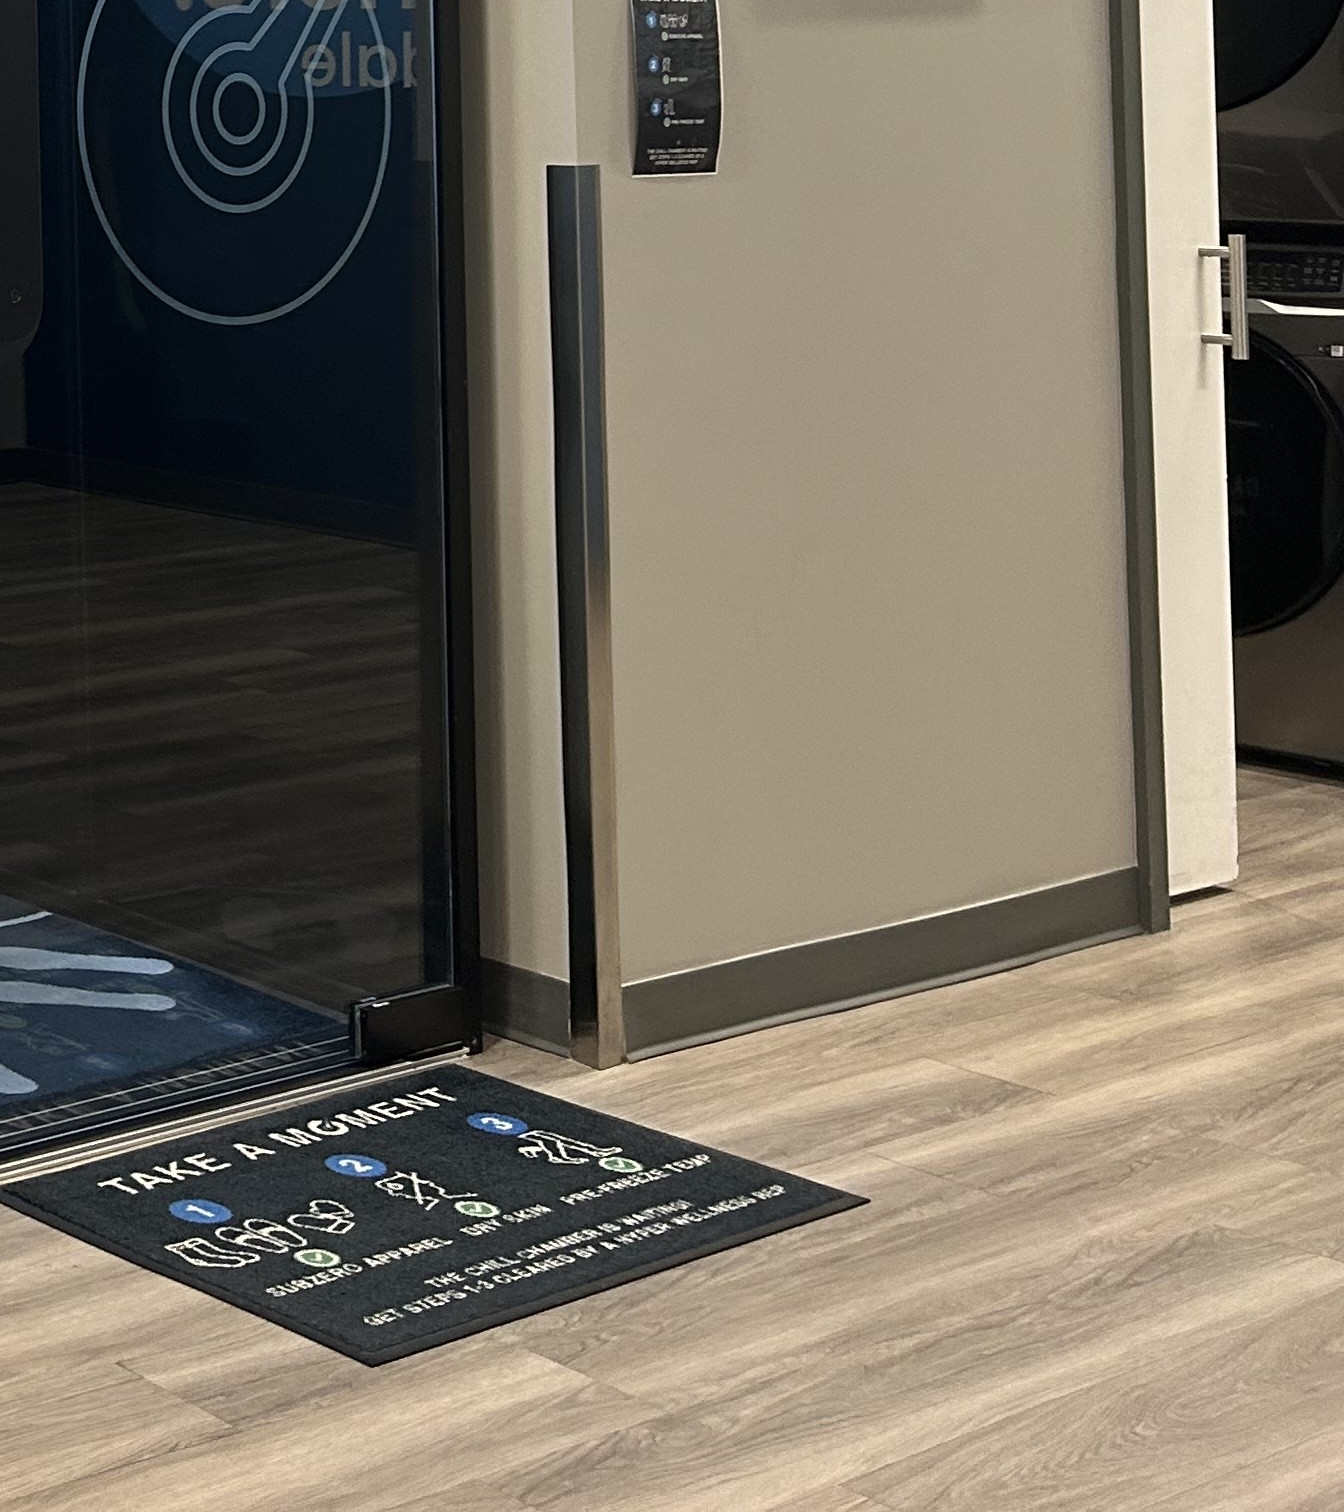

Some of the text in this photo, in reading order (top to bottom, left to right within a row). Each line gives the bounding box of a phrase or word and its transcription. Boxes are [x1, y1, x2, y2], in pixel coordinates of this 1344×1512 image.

[98, 1087, 457, 1196] TAKE A MOMENT
[483, 1117, 514, 1131] 3
[339, 1159, 374, 1174] 2
[560, 1153, 712, 1206] PRE-FREEZE TEMP
[185, 1204, 215, 1218] 1
[459, 1203, 553, 1237] DRY SKIN
[265, 1237, 454, 1298] SUBZERO APPAREL
[363, 1184, 787, 1327] GET STEPS 1-3 CLEARED BY A HYPER WELLNESS REP
[424, 1272, 466, 1288] THE
[464, 1256, 521, 1277] CHILL
[516, 1228, 602, 1260] CHAMBER
[597, 1222, 621, 1233] IS
